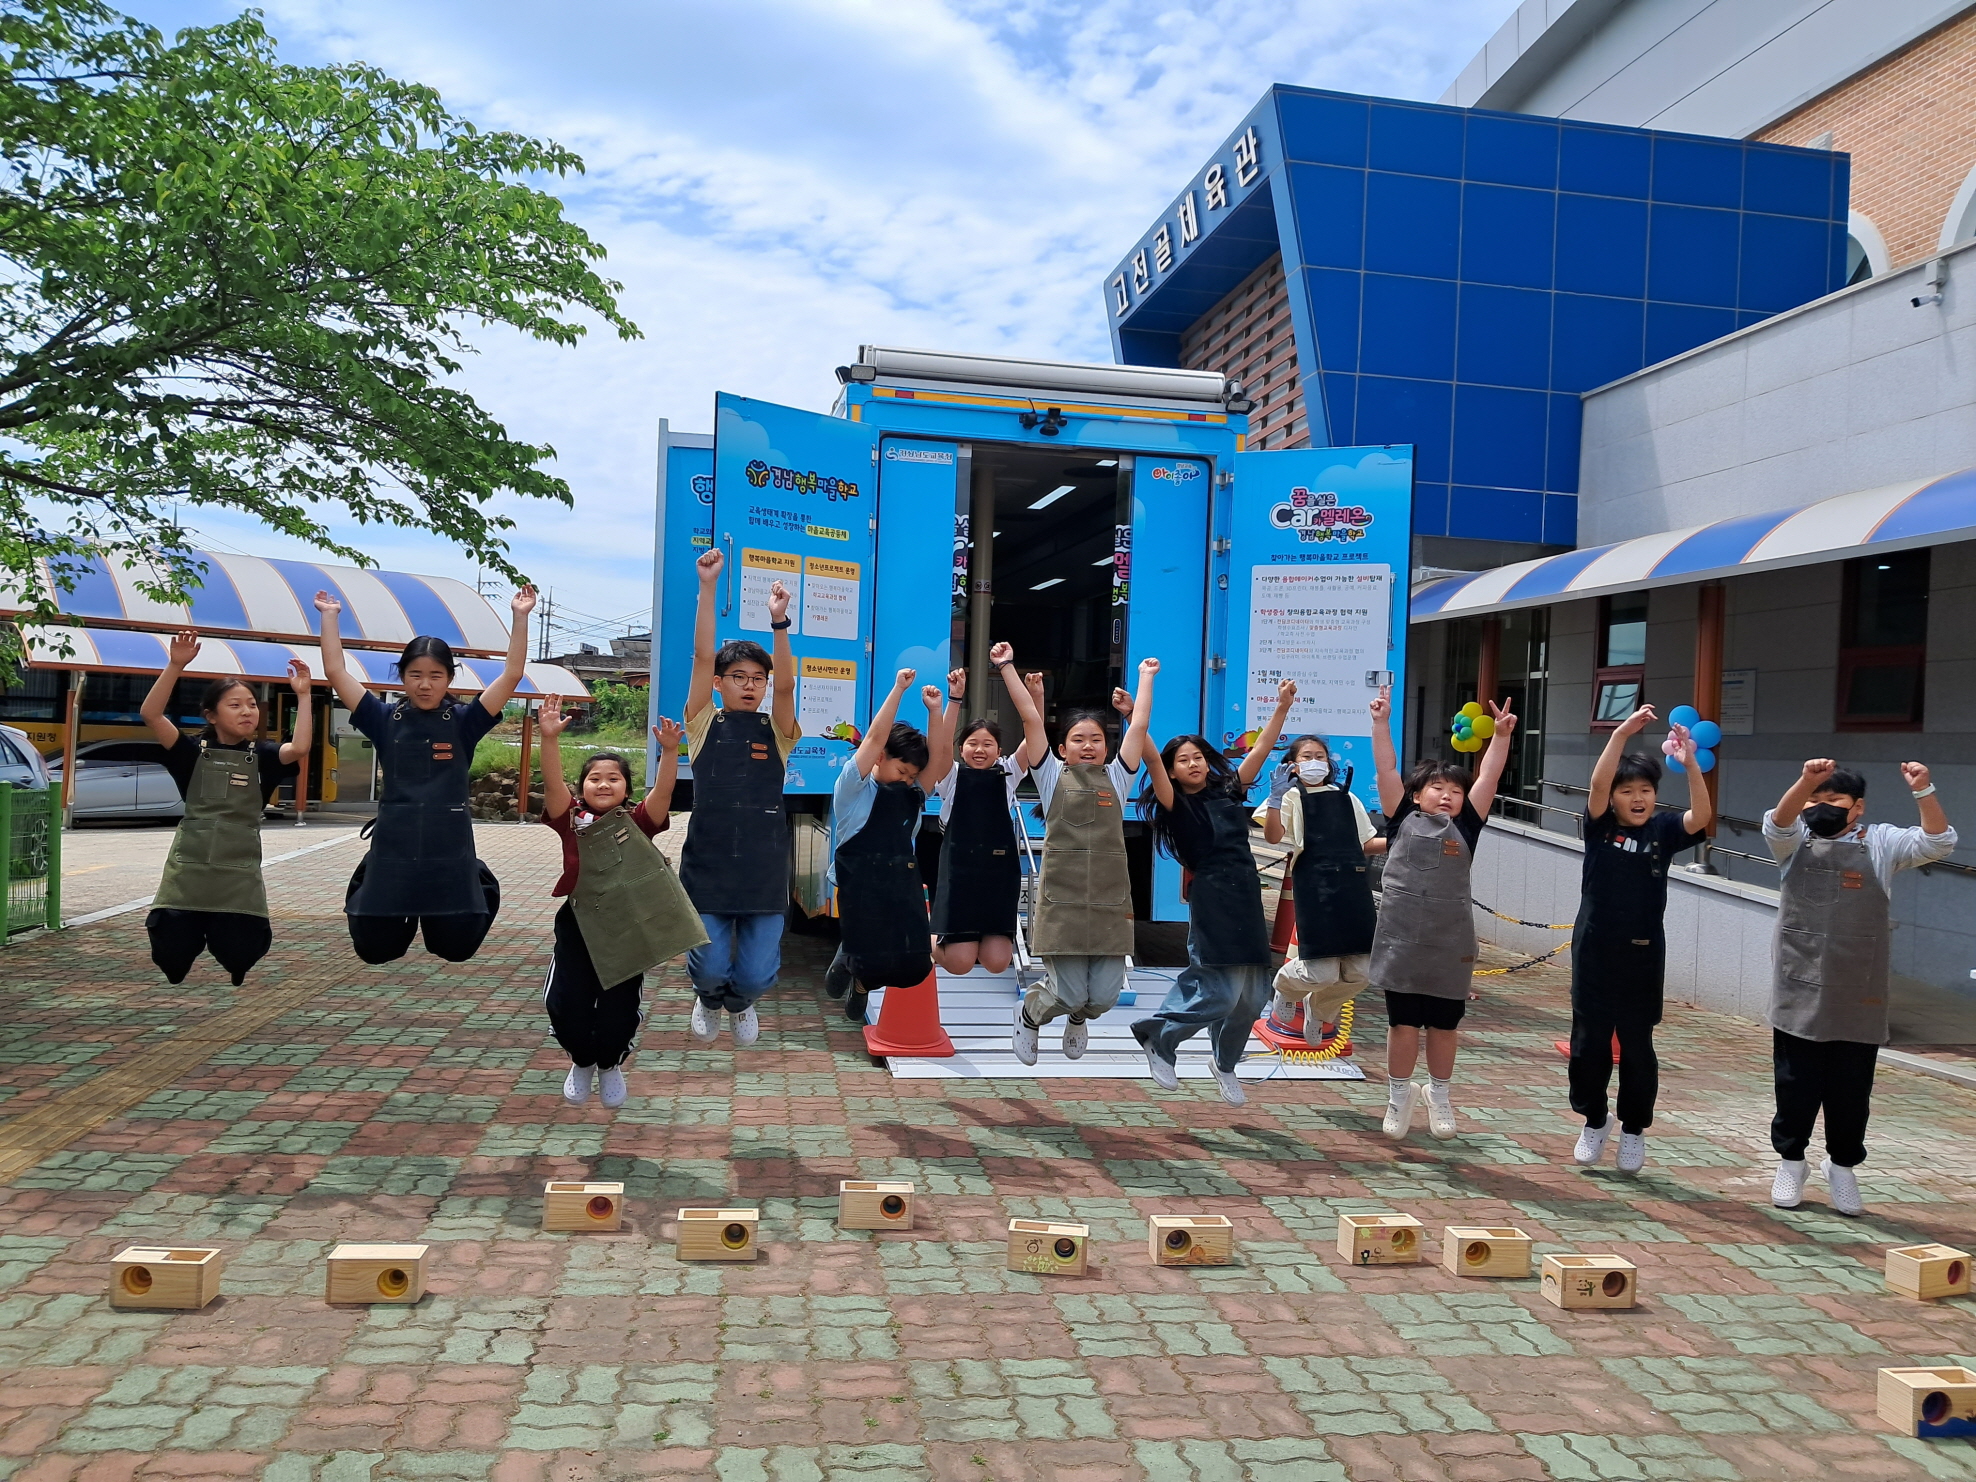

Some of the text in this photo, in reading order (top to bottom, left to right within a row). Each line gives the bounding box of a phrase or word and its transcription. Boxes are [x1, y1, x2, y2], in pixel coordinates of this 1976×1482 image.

[1111, 125, 1261, 318] 고전골체육관
[770, 466, 859, 501] 경남행복마을학교
[1291, 488, 1336, 507] 꿈을 실은
[806, 525, 848, 539] 마을교육공동체
[1299, 527, 1365, 543] 경남행복마을학교
[748, 553, 796, 568] 행복마을학교 지원
[1270, 552, 1370, 562] 찾아가는 행복마을학교 프로젝트
[1261, 575, 1280, 583] 다양한
[1335, 575, 1354, 583] 가능한
[1260, 609, 1286, 617] 학생중심
[1355, 609, 1368, 617] 지원
[806, 664, 839, 675] 청소년시민단
[1302, 696, 1316, 705] 지원
